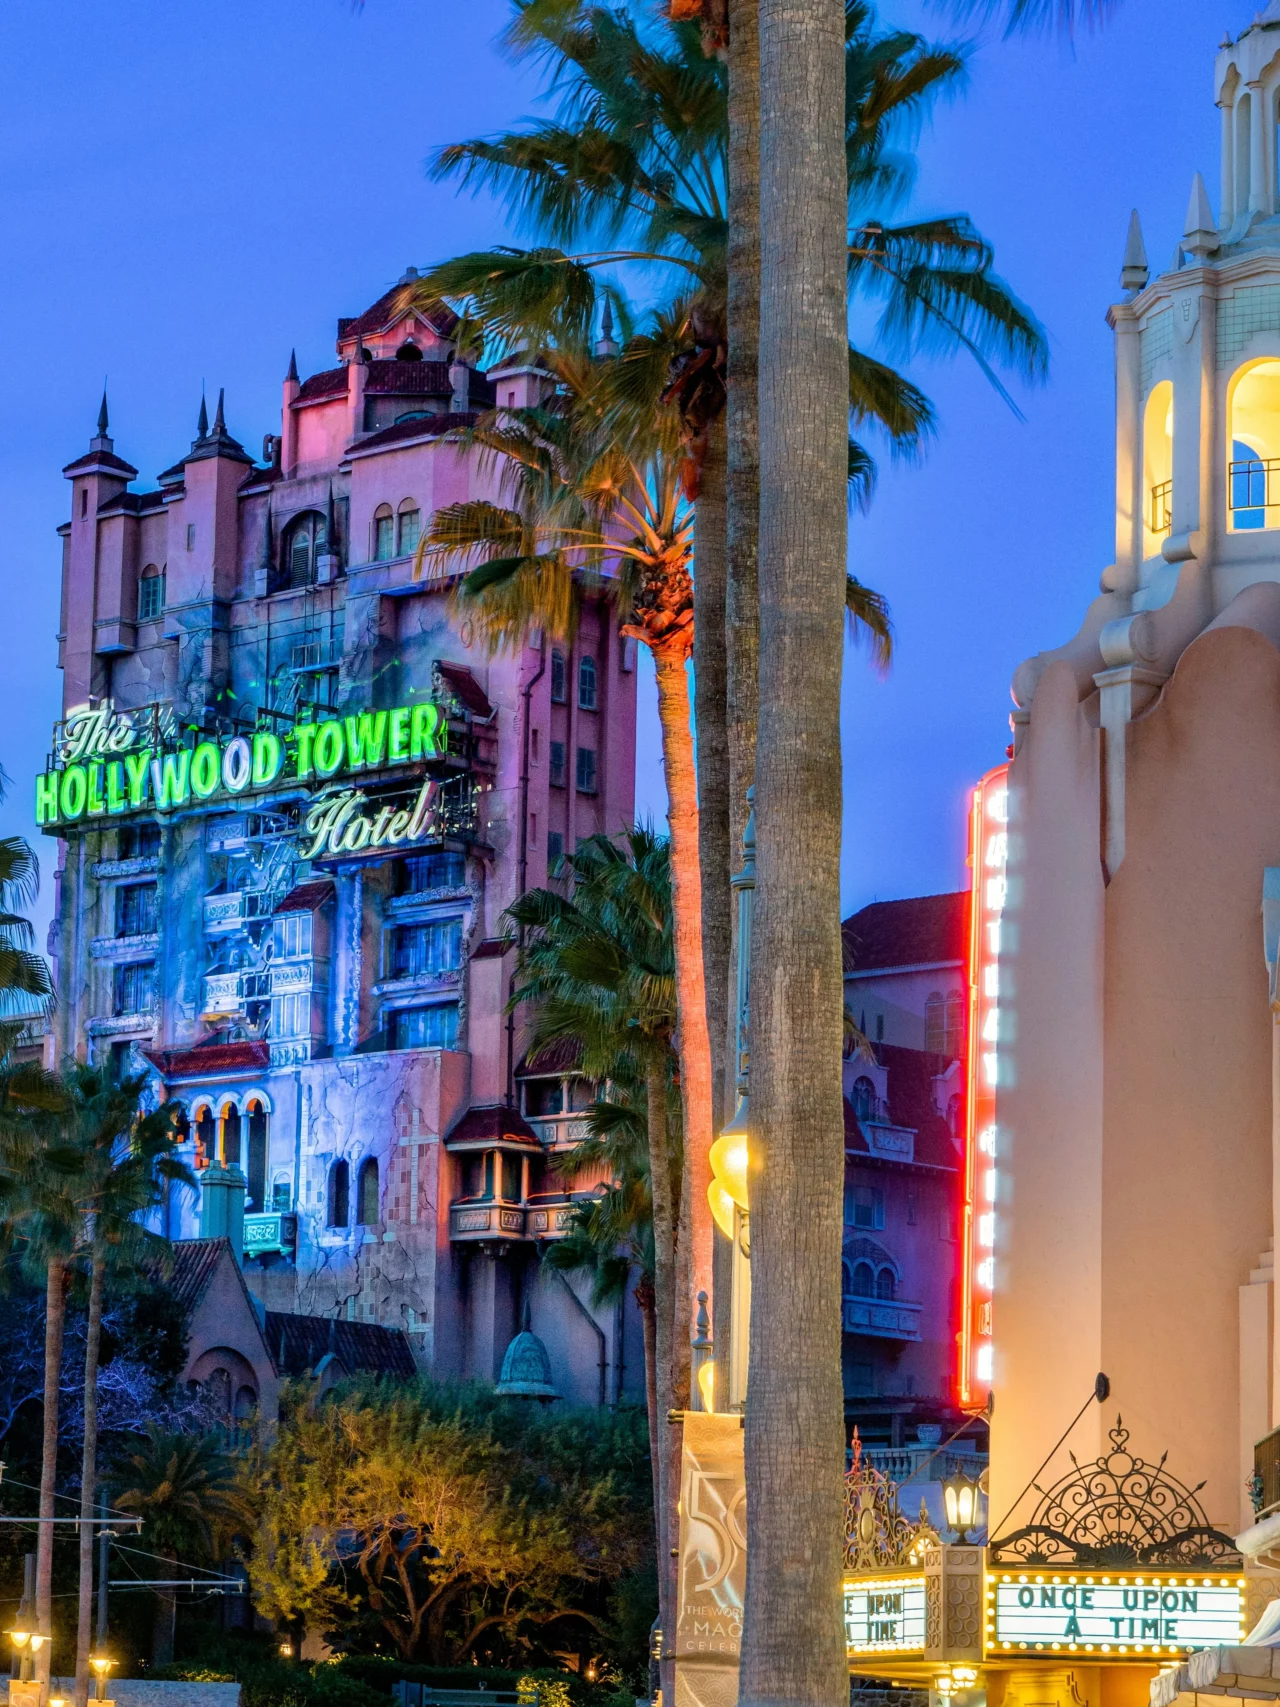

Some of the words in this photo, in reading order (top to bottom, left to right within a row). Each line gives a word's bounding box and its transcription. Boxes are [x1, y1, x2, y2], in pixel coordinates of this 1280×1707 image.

[60, 704, 137, 762] The
[35, 738, 285, 827] HOLLYWOOD
[297, 703, 440, 781] TOWER
[300, 781, 439, 861] Hotel
[685, 1606, 707, 1616] THE
[711, 1607, 744, 1618] WORL
[868, 1593, 901, 1616] UPON
[1018, 1586, 1095, 1610] ONCE
[1122, 1588, 1198, 1613] UPON
[868, 1620, 897, 1642] TIME
[1064, 1615, 1082, 1638] A
[1109, 1616, 1179, 1640] TIME
[686, 1641, 737, 1652] CELEB
